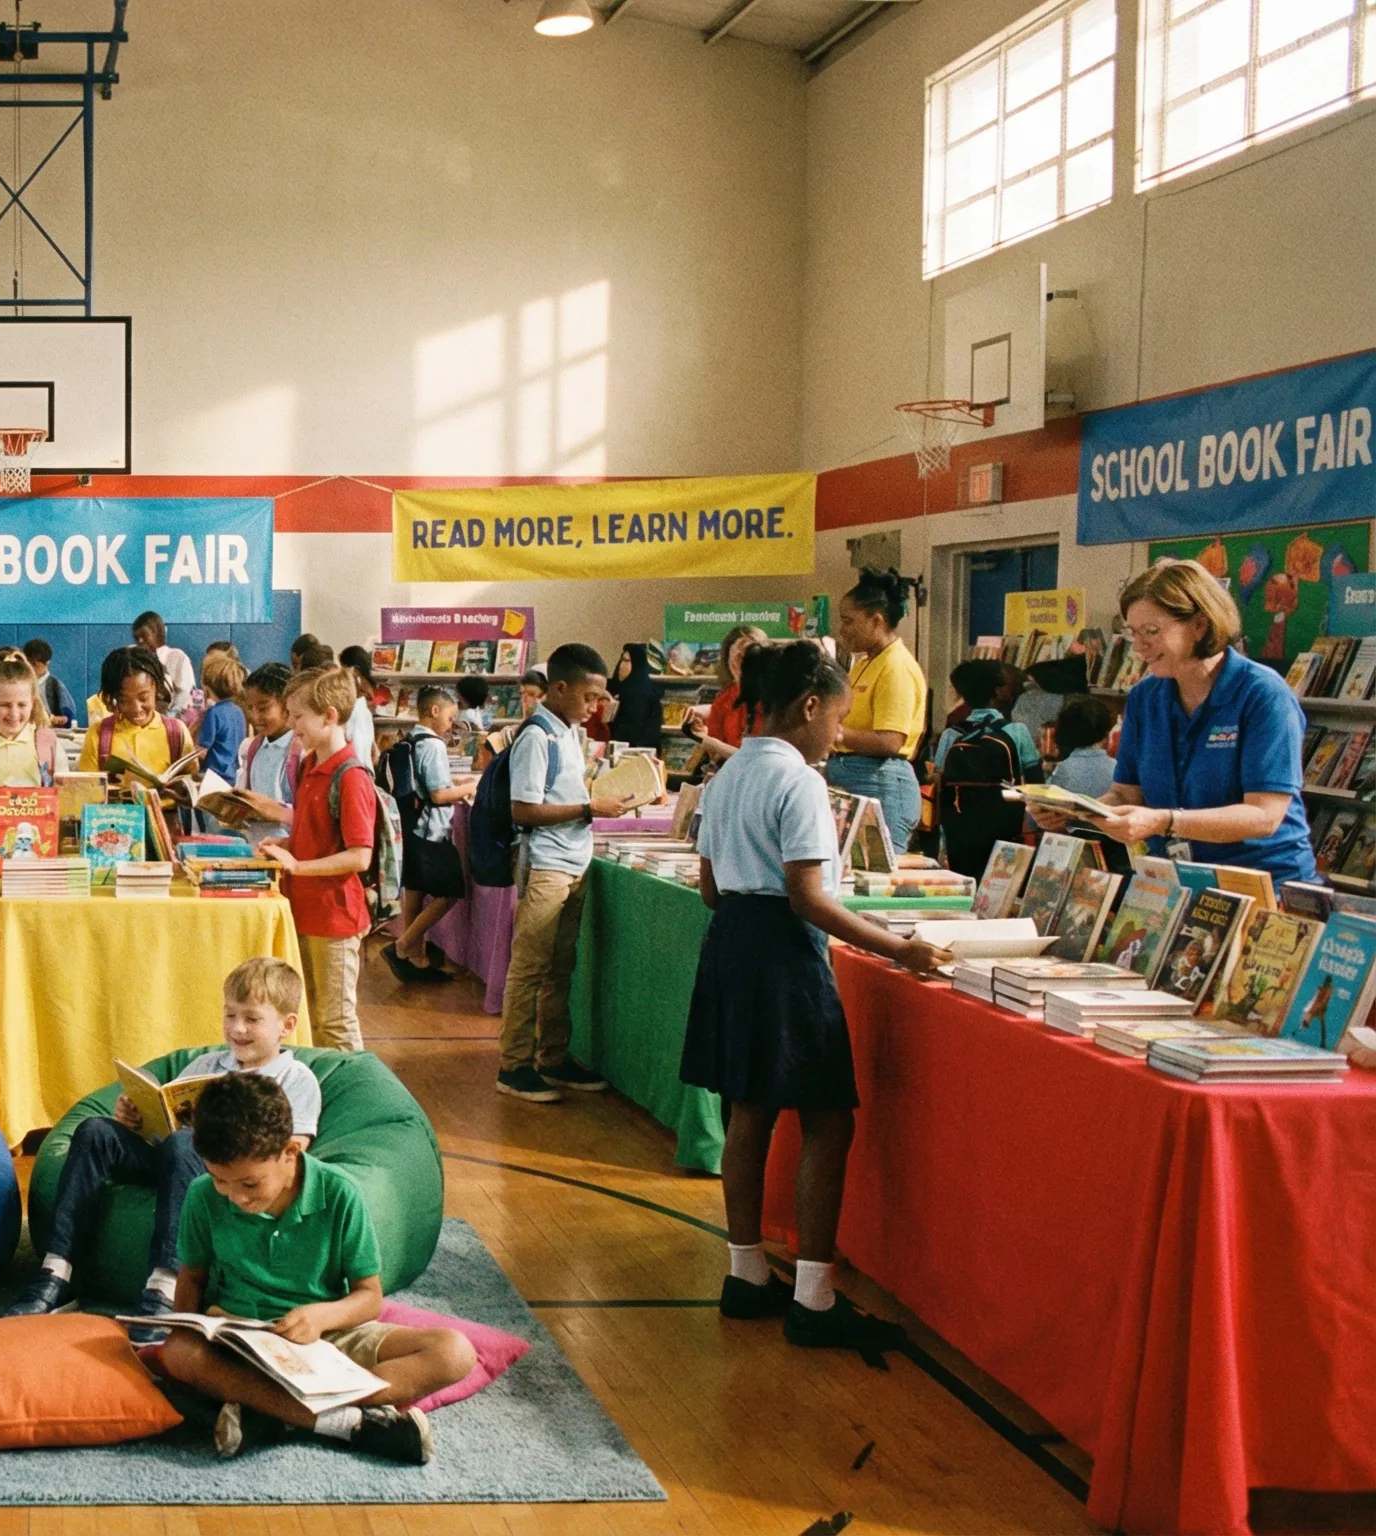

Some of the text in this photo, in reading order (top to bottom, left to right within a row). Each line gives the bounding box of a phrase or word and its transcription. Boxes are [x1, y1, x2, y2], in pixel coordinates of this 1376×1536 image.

[1090, 407, 1373, 503] SCHOOL BOOK FAIR
[412, 505, 794, 549] READ MORE, LEARN MORE.
[145, 534, 251, 585] FAIR
